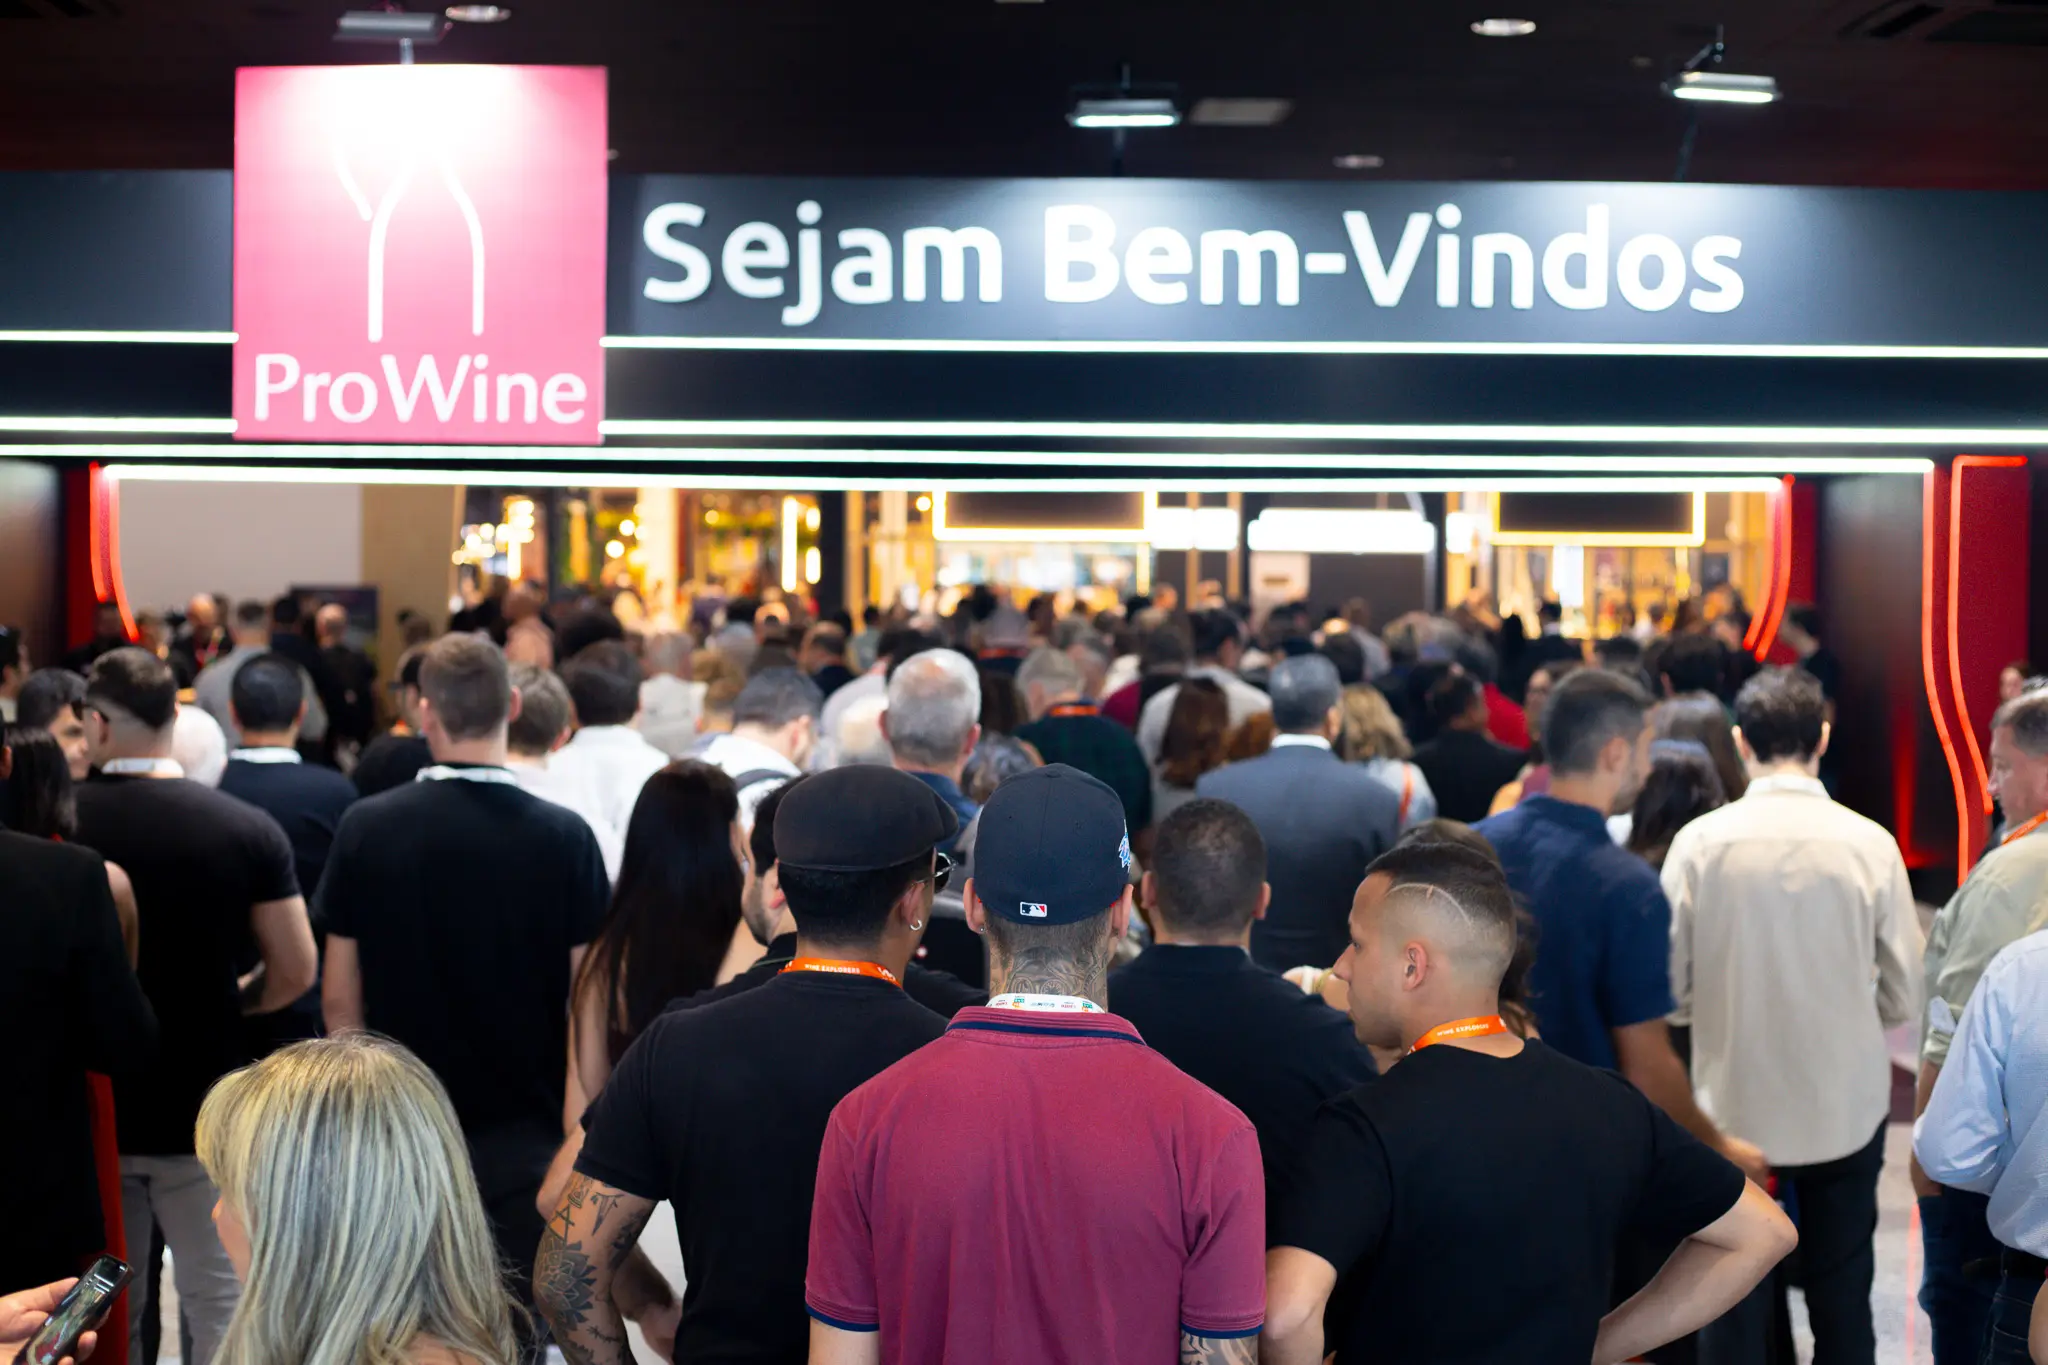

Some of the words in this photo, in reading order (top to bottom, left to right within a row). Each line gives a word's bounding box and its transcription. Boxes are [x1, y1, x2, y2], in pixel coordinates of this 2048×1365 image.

[643, 200, 1003, 326] Sejam
[1043, 203, 1746, 313] Bem-Vindos
[254, 353, 588, 424] ProWine
